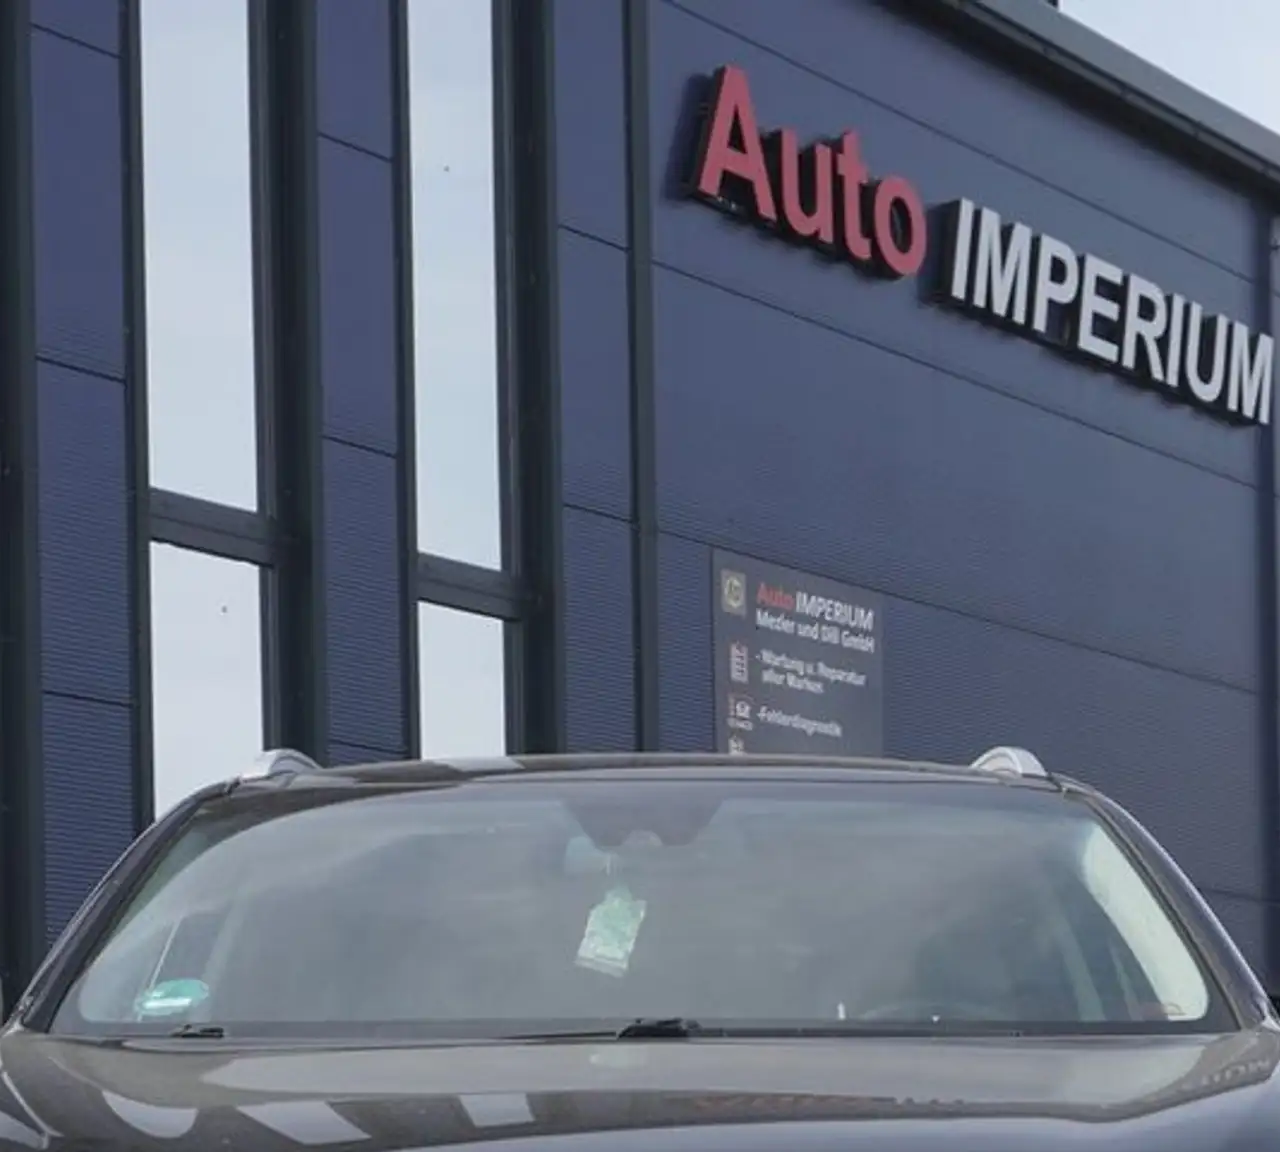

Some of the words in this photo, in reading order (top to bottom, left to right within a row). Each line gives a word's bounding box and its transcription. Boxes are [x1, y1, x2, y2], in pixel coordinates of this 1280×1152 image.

[696, 65, 928, 277] Auto
[951, 198, 1275, 425] IMPERIUM
[757, 582, 795, 611] Auto
[795, 591, 874, 632] IMPERIUM
[797, 622, 819, 640] und
[841, 630, 875, 653] GmbH
